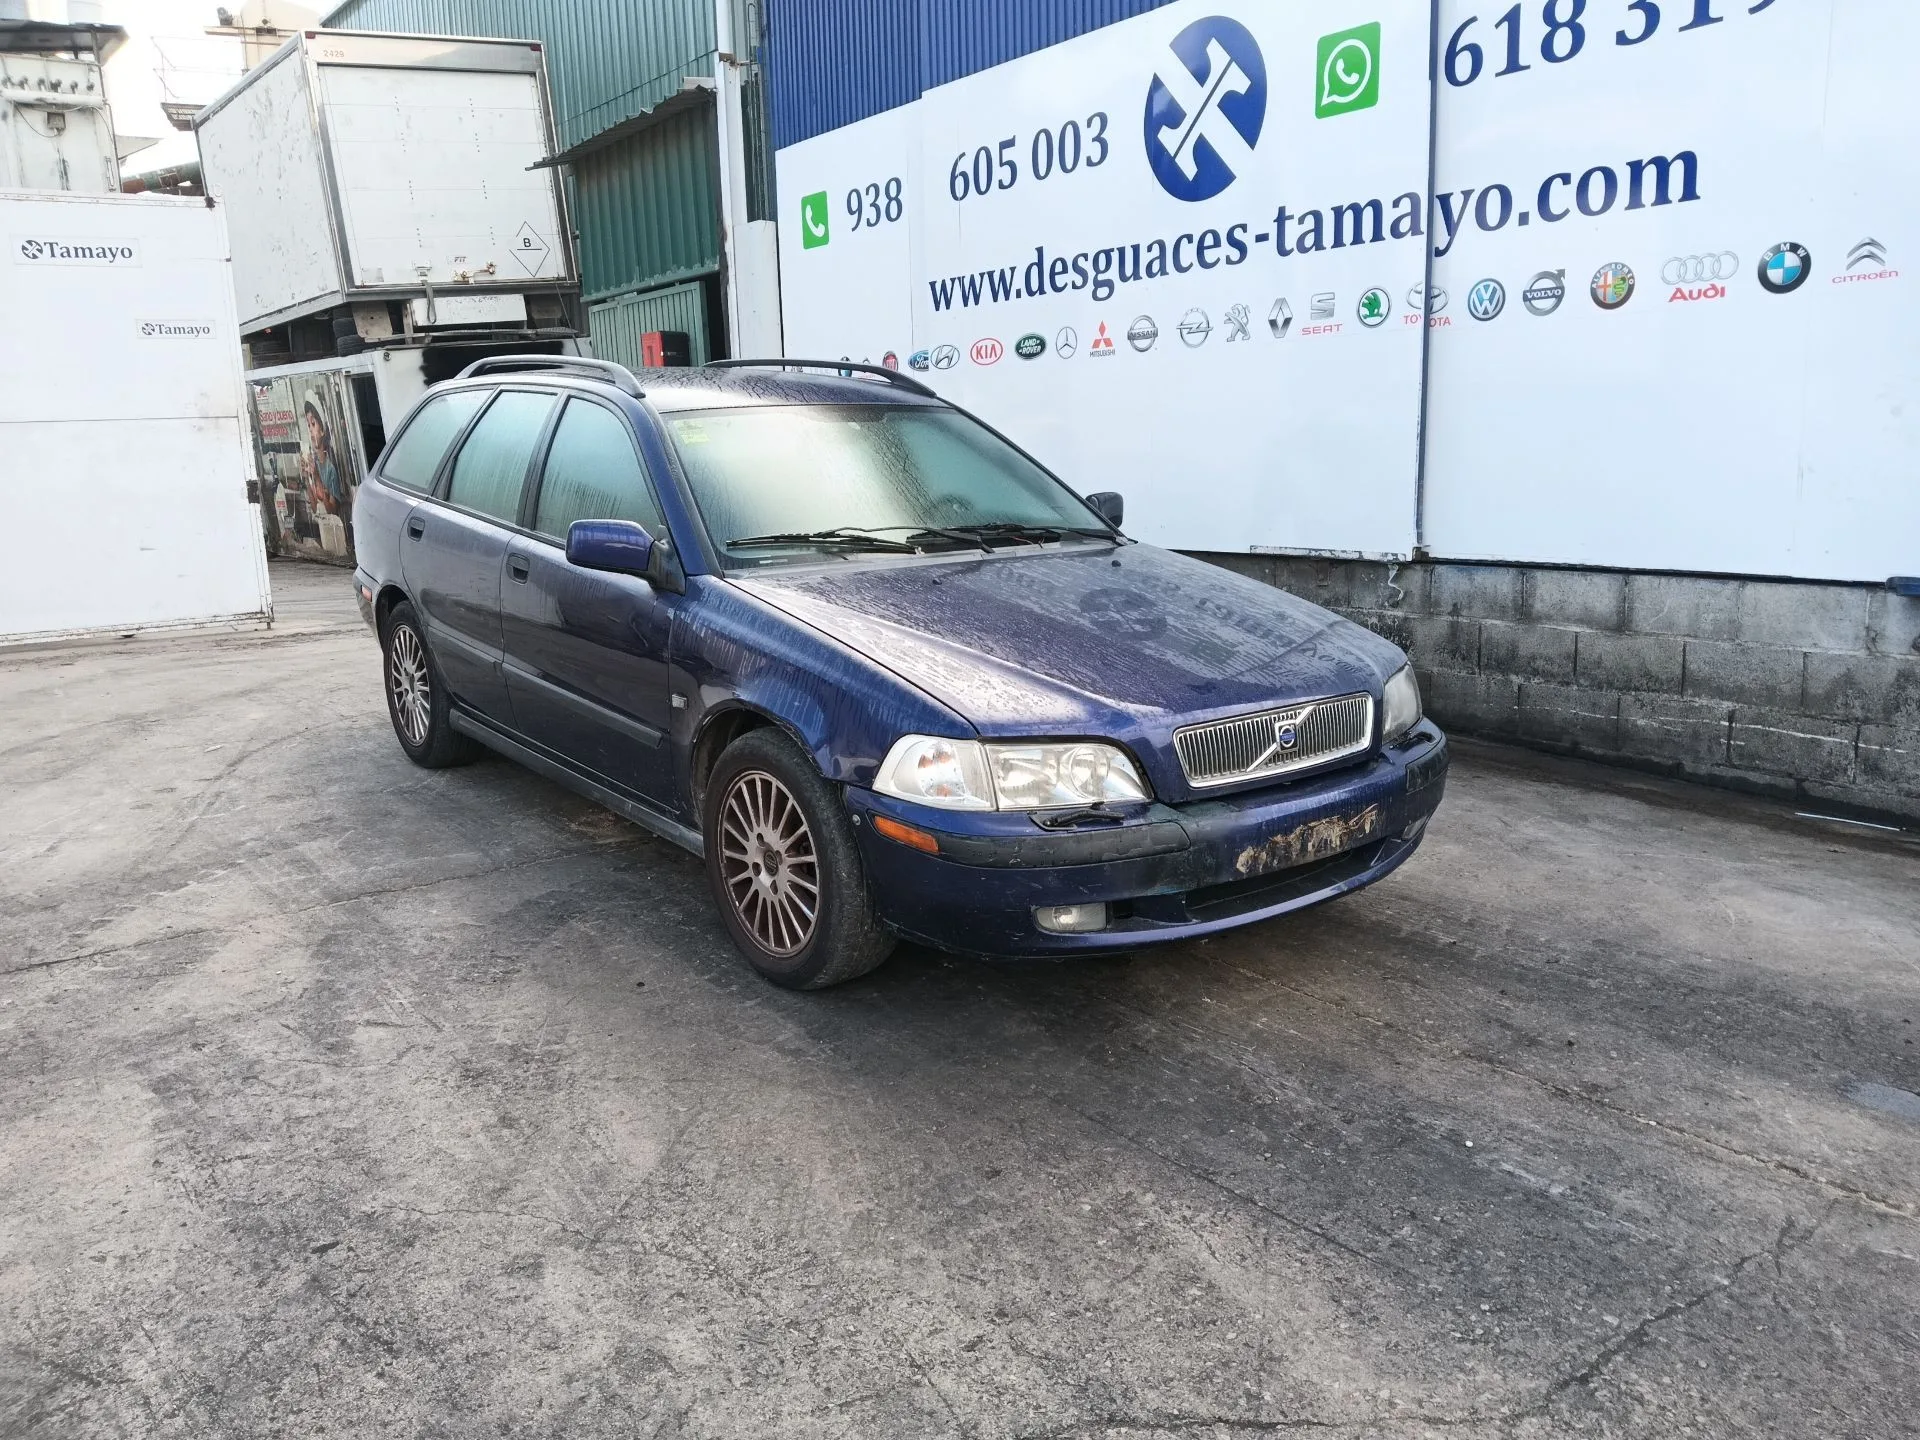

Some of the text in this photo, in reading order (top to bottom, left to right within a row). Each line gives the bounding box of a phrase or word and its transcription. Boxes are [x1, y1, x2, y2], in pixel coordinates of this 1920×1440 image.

[1444, 0, 1587, 87] 618
[846, 111, 1109, 232] 938 605 003
[929, 149, 1701, 311] www.desguaces-tamayo.com
[523, 237, 532, 248] B
[44, 242, 133, 263] Tamayo
[1763, 242, 1807, 261] BMW
[1525, 288, 1562, 299] VOLVO
[1668, 283, 1726, 303] Audi
[1403, 314, 1451, 328] TOOTA
[155, 323, 210, 337] Tamayo
[1128, 329, 1157, 340] NISSAN
[1301, 323, 1343, 336] SEAT
[1020, 338, 1037, 348] LAND
[1022, 345, 1042, 355] ROVER
[976, 344, 998, 360] KIA
[1089, 349, 1116, 358] MITSUBISHI
